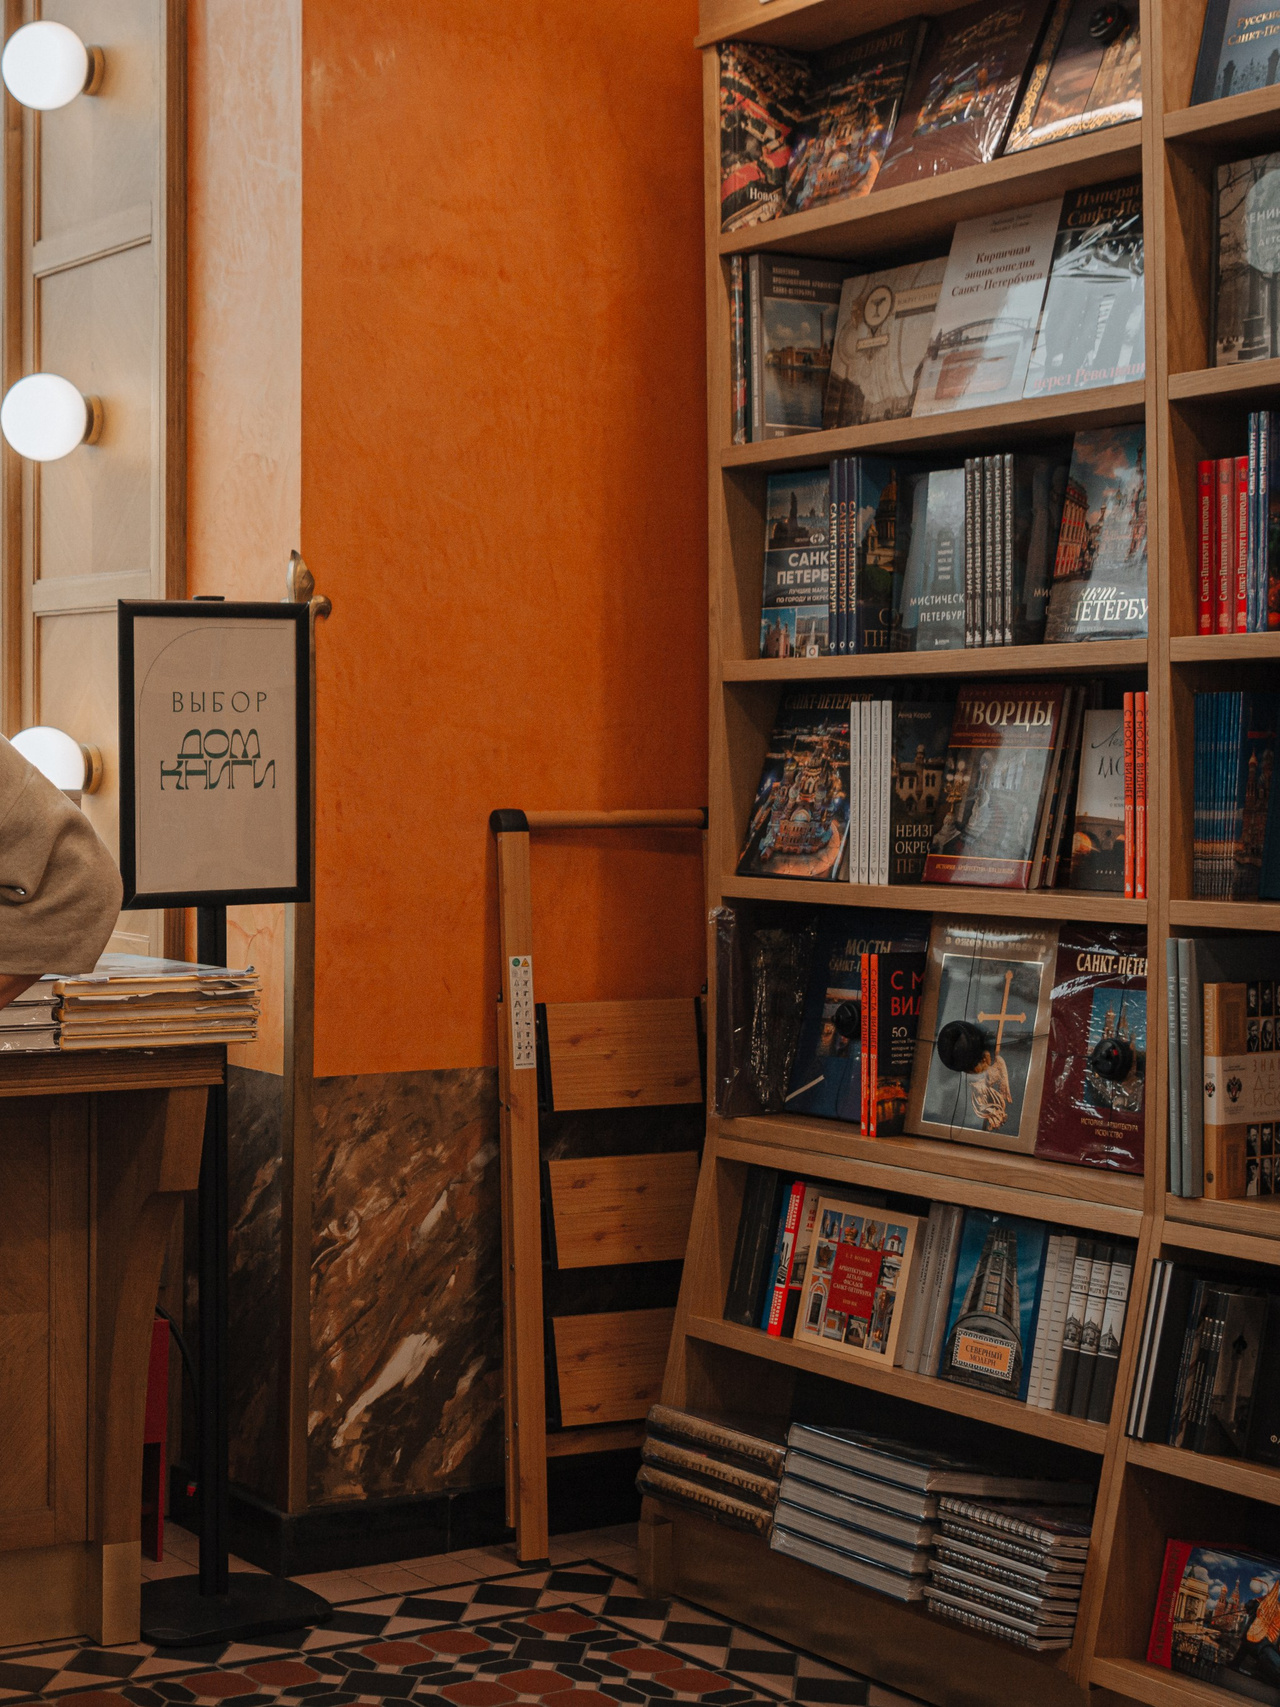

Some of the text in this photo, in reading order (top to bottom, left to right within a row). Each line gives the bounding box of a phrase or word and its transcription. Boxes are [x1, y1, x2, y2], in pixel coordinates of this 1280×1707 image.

[976, 245, 1031, 264] Кирпичная
[965, 258, 1035, 281] энциклопедия
[951, 272, 1043, 297] Санкт-Петербурга
[788, 551, 829, 567] САНК
[777, 570, 829, 585] ПЕТЕРБ
[910, 593, 964, 606] МИСТИЧЕСК
[172, 691, 267, 713] ВЫБОР
[957, 700, 1056, 732] ДВОРЦЫ
[177, 728, 261, 759] ДОМ
[1124, 721, 1132, 757] МОСТА
[1136, 721, 1144, 758] МОСТА
[160, 759, 276, 791] КНИГИ
[1125, 762, 1133, 799] ВИДНЕЕ
[1136, 763, 1144, 800] ВИДНЕЕ
[845, 939, 892, 956] МОСТЫ
[890, 970, 904, 990] С
[1168, 975, 1176, 1043] ЛЕНИНГРАД
[1180, 977, 1189, 1045] ЛЕНИНГРАД
[965, 1344, 1003, 1361] СЕВЕРНЫЙ
[969, 1354, 996, 1368] МОДЕРН
